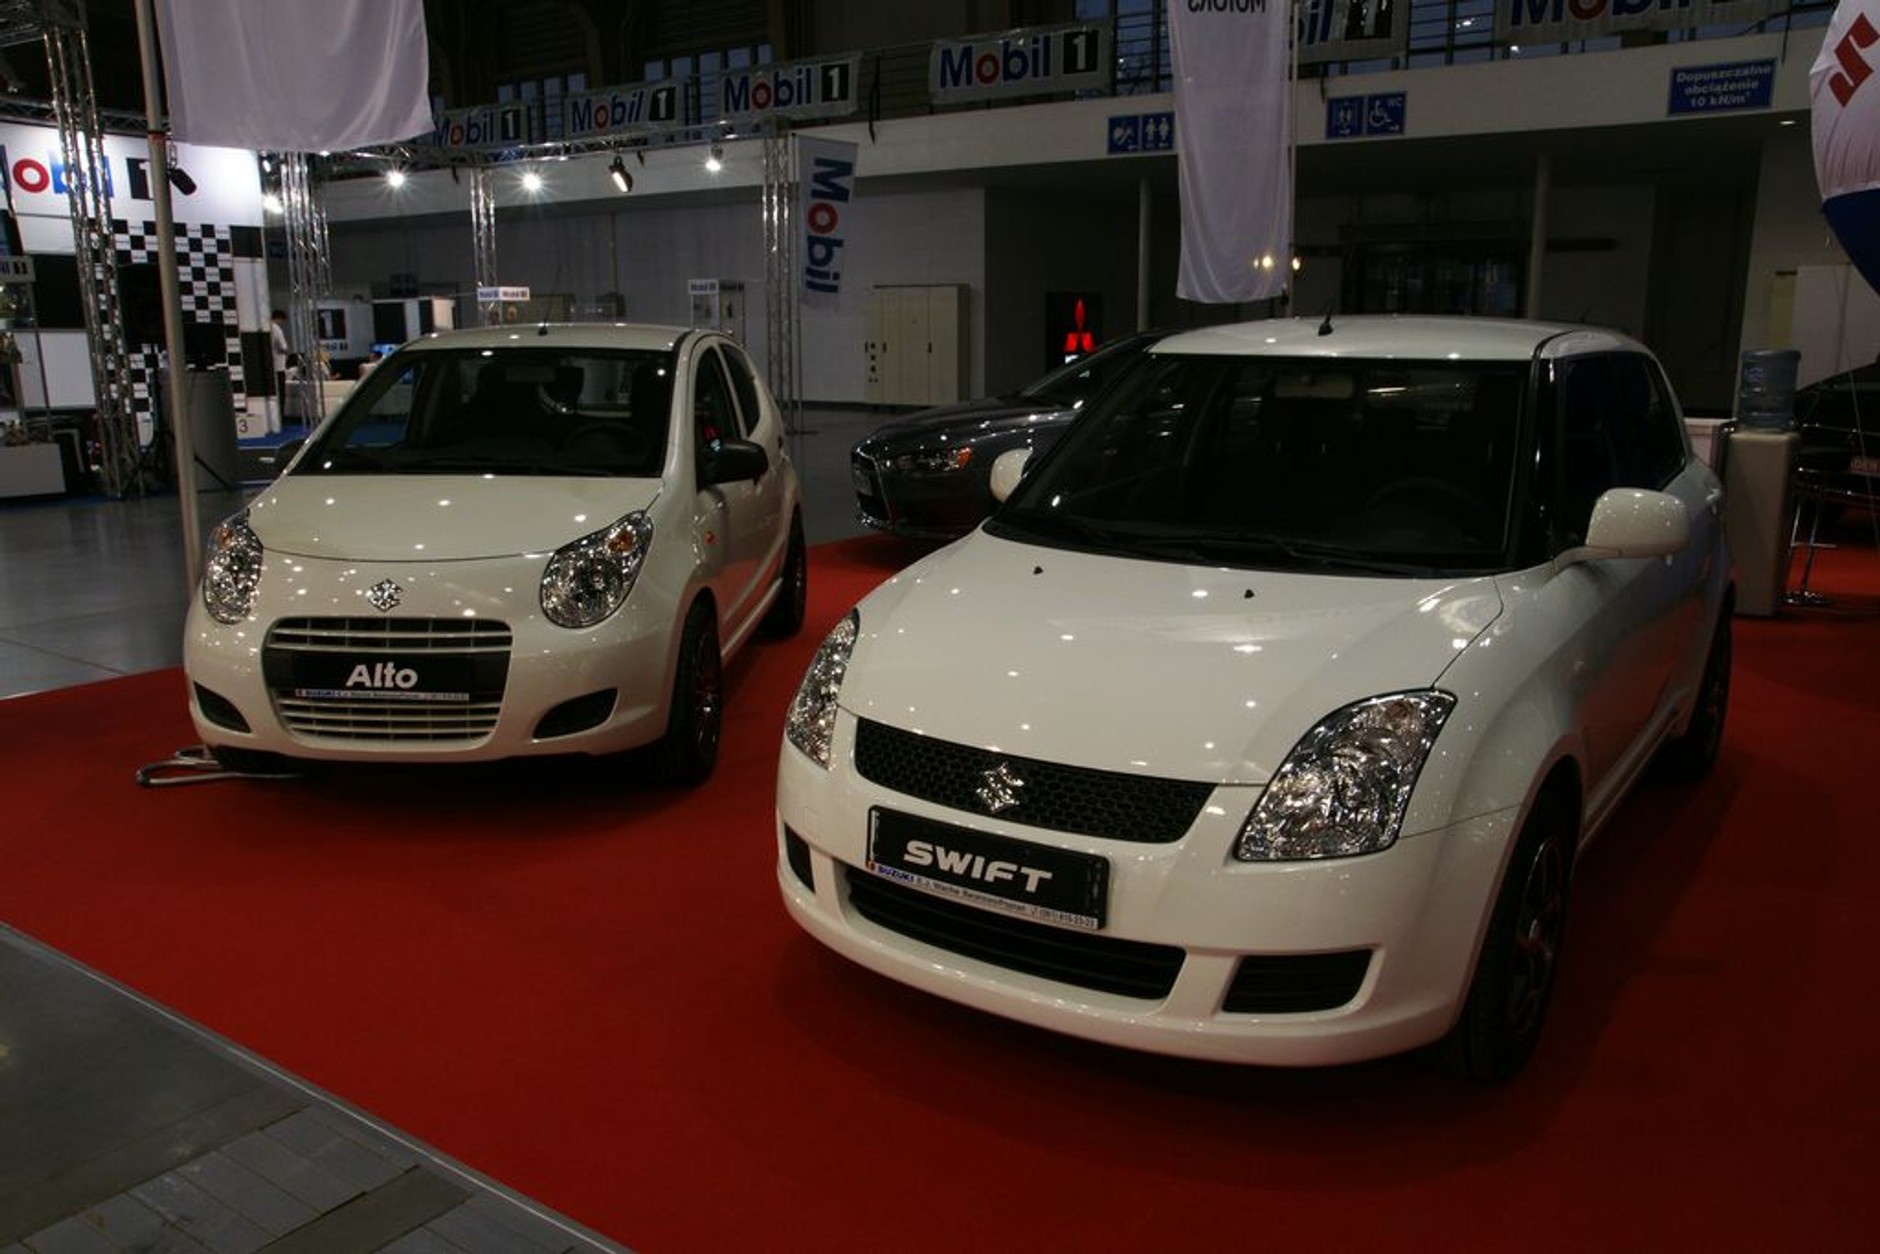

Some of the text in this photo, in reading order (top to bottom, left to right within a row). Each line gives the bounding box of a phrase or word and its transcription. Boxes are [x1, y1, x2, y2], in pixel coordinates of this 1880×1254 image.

[940, 36, 1052, 89] Mobil
[572, 92, 643, 132] Mobil
[725, 68, 812, 113] Mobil
[433, 112, 494, 147] Mobil
[806, 158, 853, 293] Mobil
[345, 661, 419, 689] Alto
[903, 839, 1053, 893] SWIFT
